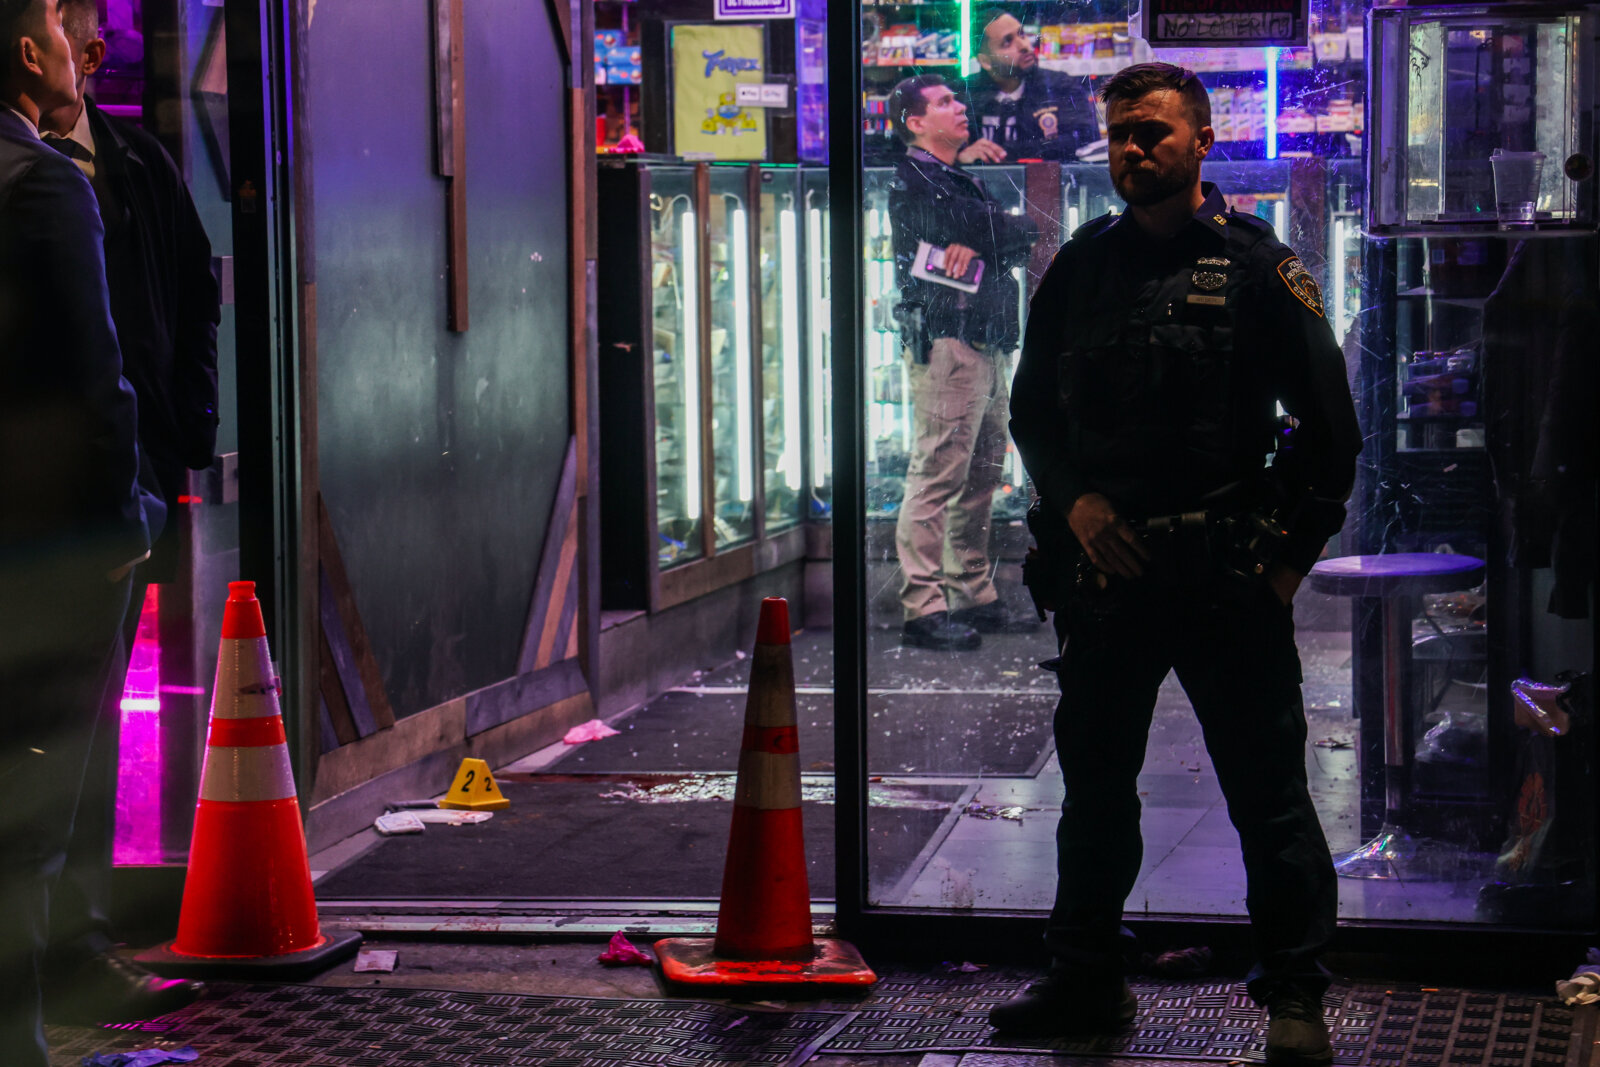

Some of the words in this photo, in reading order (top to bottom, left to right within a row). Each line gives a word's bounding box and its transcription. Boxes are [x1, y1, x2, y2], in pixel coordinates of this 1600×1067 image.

[1293, 286, 1307, 300] CITY
[462, 770, 475, 792] 2
[484, 777, 492, 792] 2
